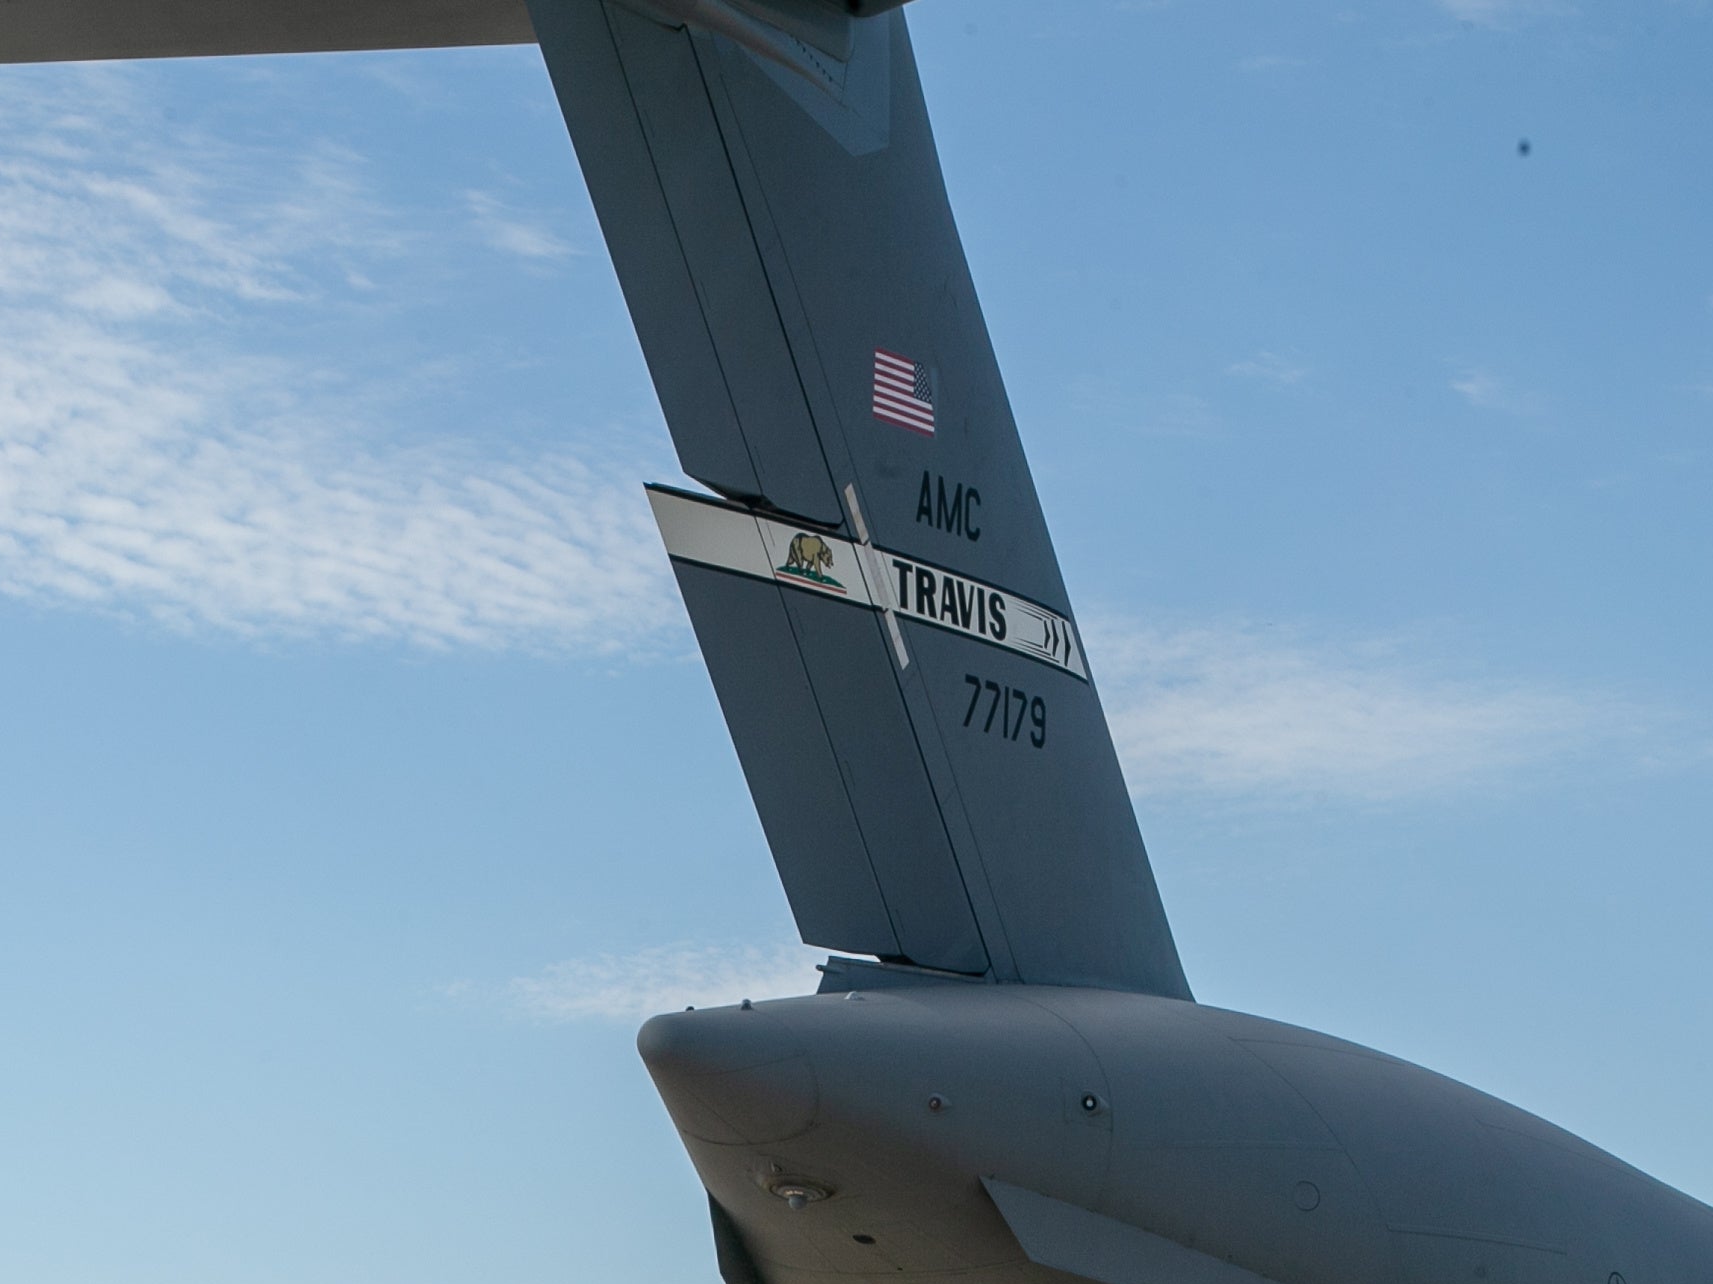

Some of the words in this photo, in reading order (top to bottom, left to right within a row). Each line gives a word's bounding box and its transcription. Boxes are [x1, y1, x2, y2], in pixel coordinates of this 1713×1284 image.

[916, 470, 981, 542] AMC
[892, 558, 1007, 641] TRAVIS
[963, 673, 1046, 749] 77179
